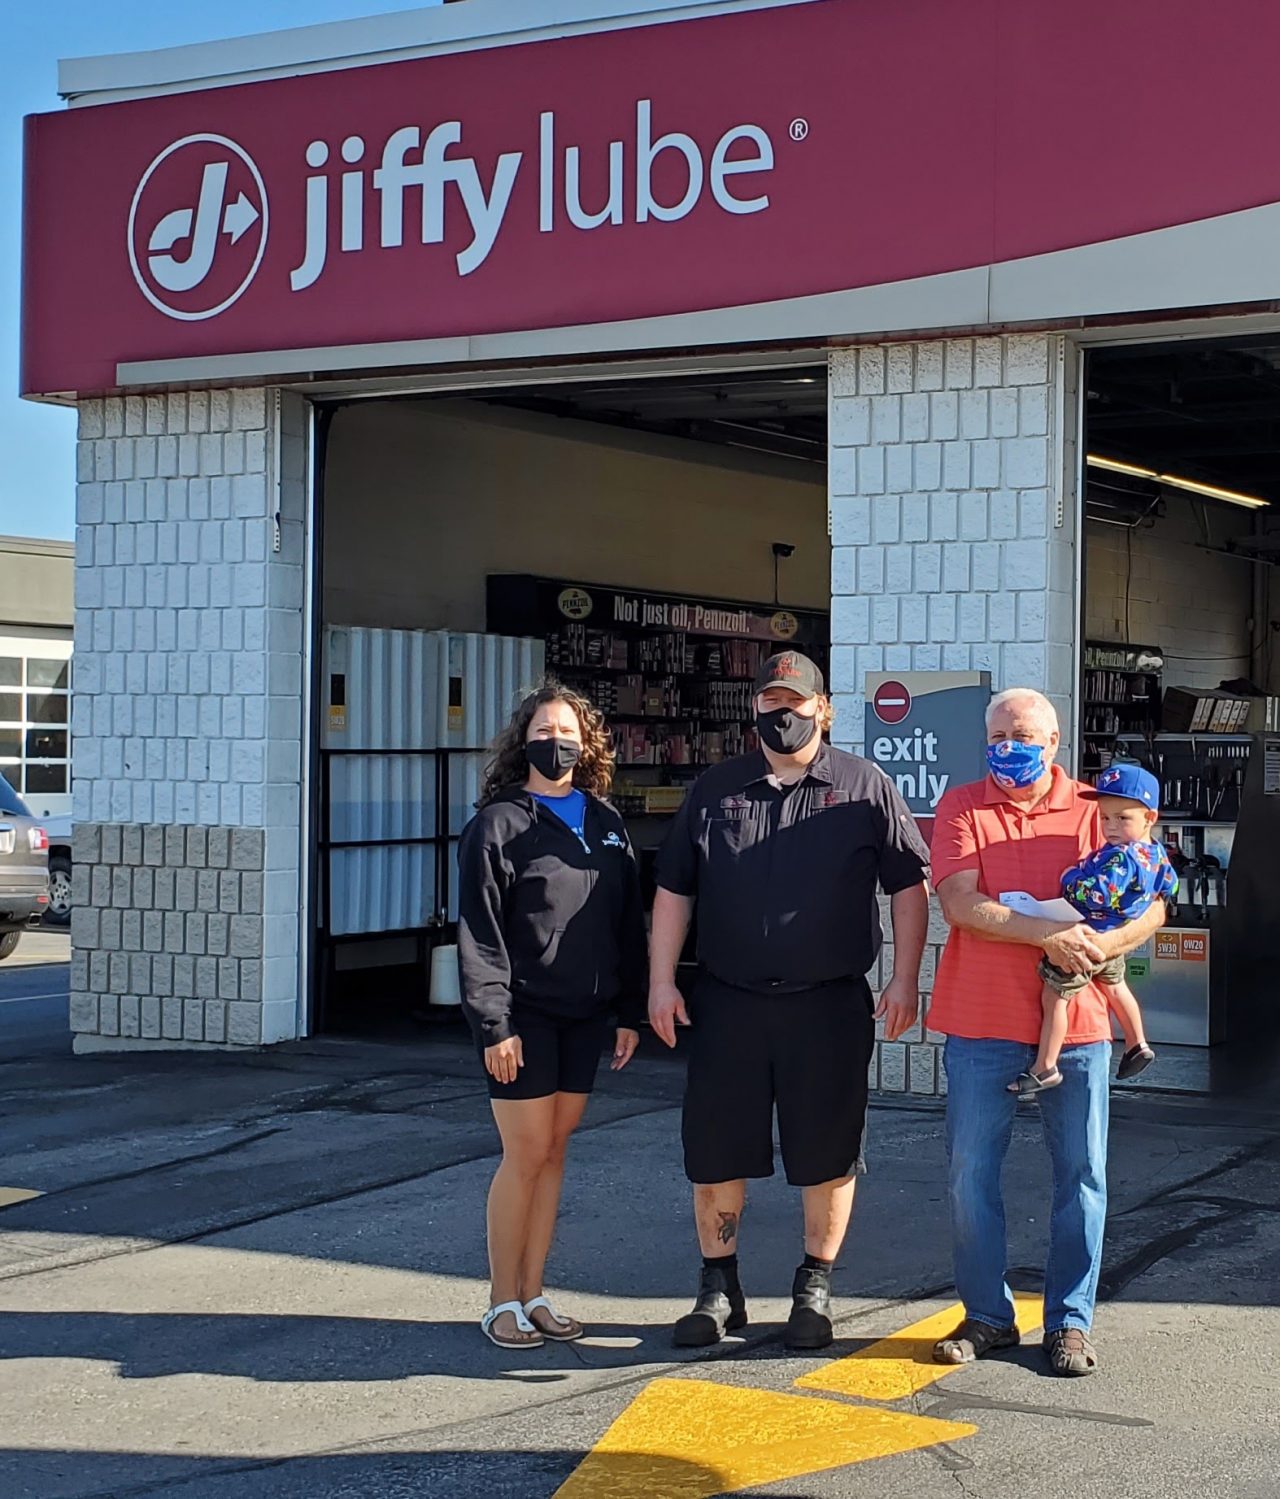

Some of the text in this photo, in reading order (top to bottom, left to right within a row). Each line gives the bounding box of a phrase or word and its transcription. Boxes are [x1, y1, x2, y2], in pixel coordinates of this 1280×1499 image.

[614, 595, 750, 633] Not just oil, Pennzoil.
[873, 728, 938, 762] exit
[895, 765, 950, 808] nly
[1157, 943, 1178, 953] 5W30
